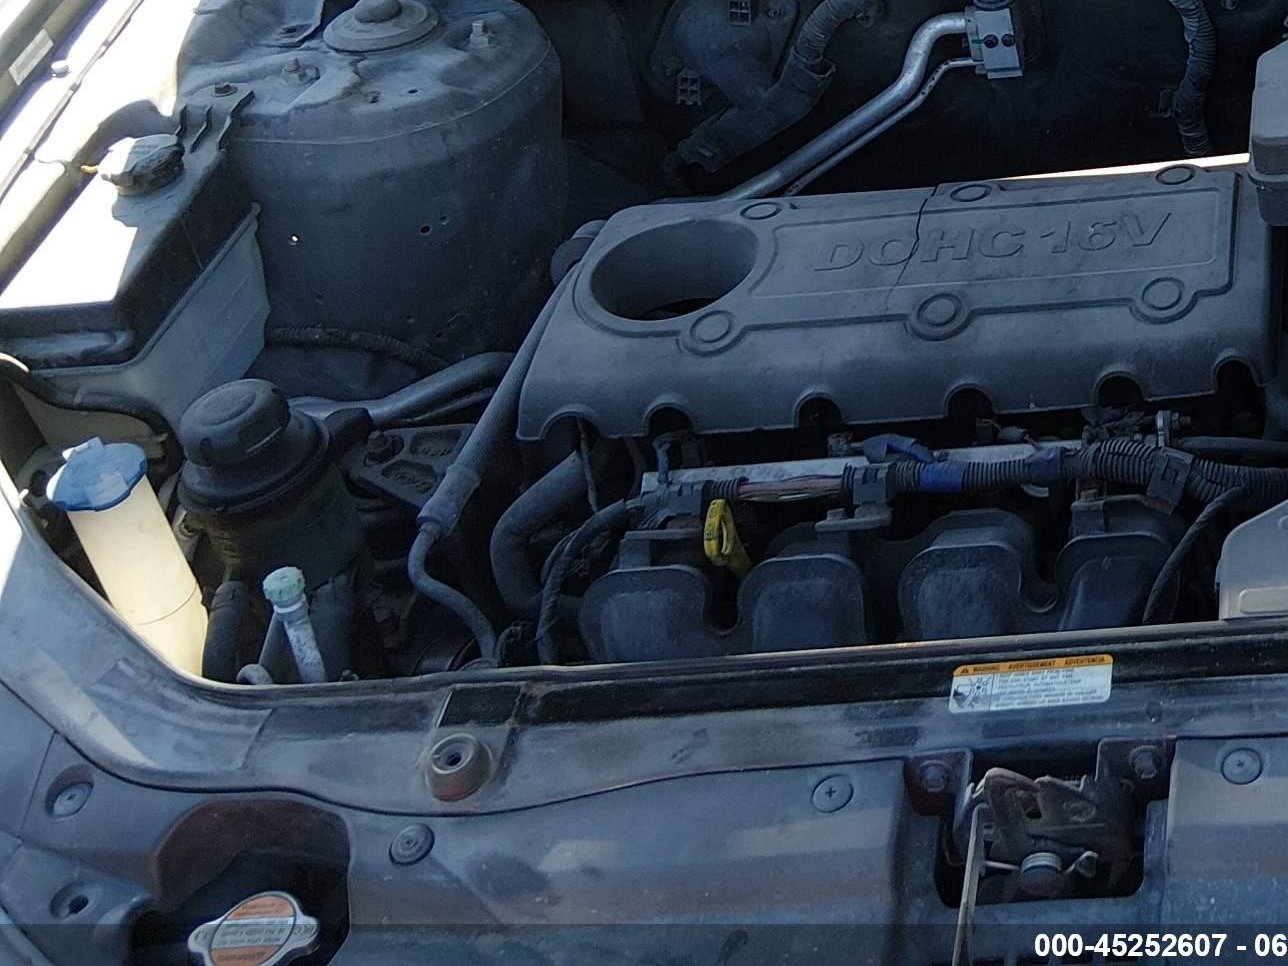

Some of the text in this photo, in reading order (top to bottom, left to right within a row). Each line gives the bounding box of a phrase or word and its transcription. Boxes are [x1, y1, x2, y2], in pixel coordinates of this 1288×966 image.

[814, 211, 1173, 273] DOHC 16V
[972, 665, 1001, 673] WARNING
